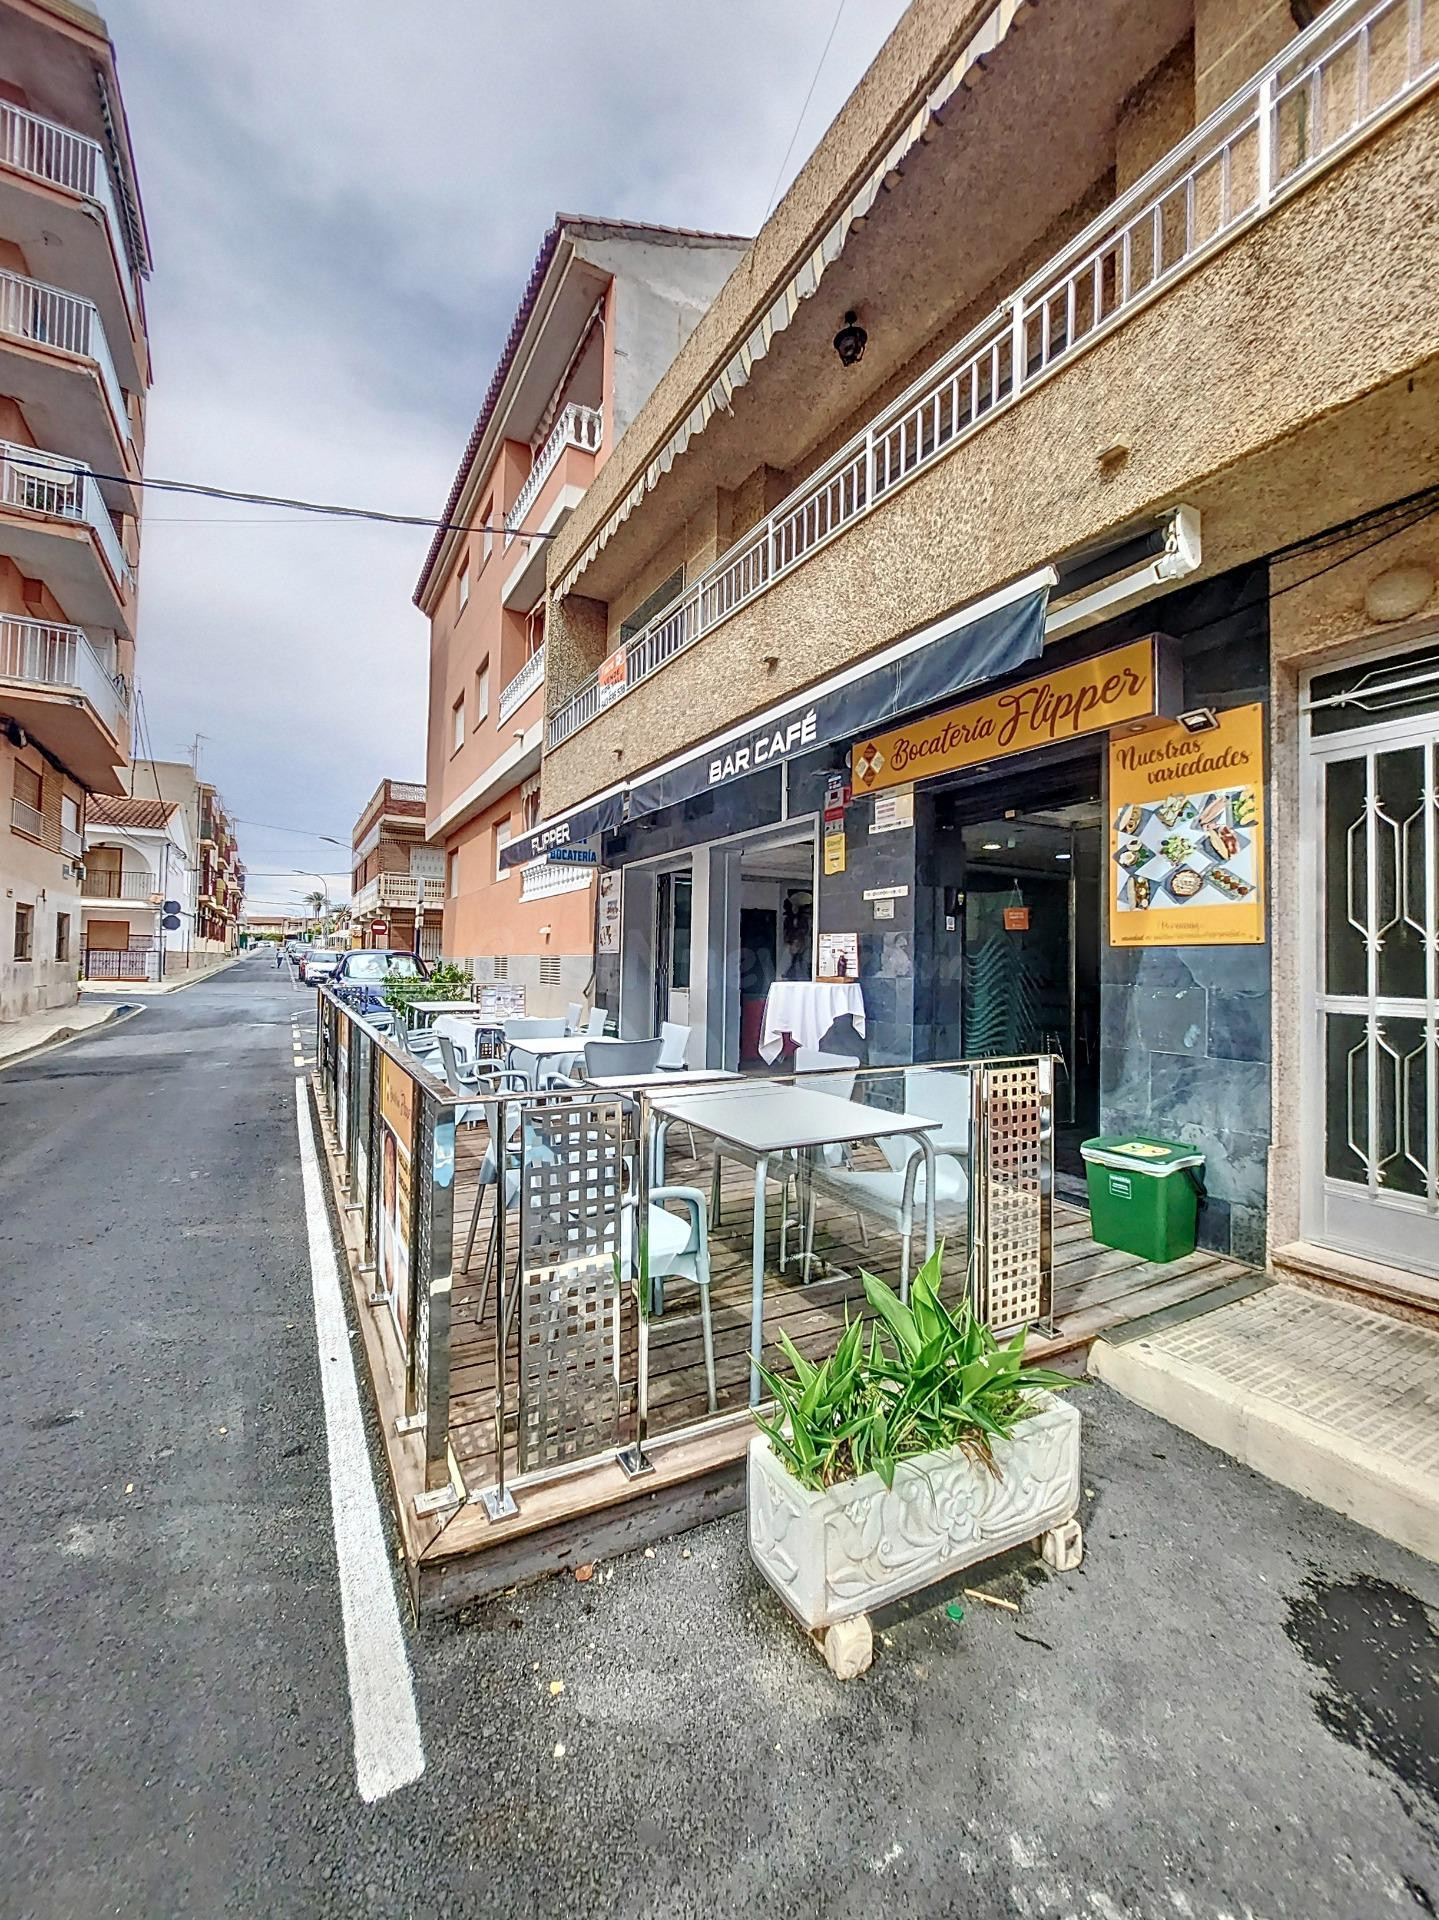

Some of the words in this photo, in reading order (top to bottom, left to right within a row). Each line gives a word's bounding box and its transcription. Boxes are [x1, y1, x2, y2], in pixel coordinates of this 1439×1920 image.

[890, 715, 996, 772] Bocatería
[997, 667, 1147, 747] Flipper
[708, 747, 751, 785] BAR
[754, 707, 817, 765] CAFÉ
[1116, 738, 1205, 772] Nuestras
[1147, 745, 1253, 785] variedades
[531, 822, 571, 856] FLIPPER
[549, 847, 597, 863] BOCATERÍA
